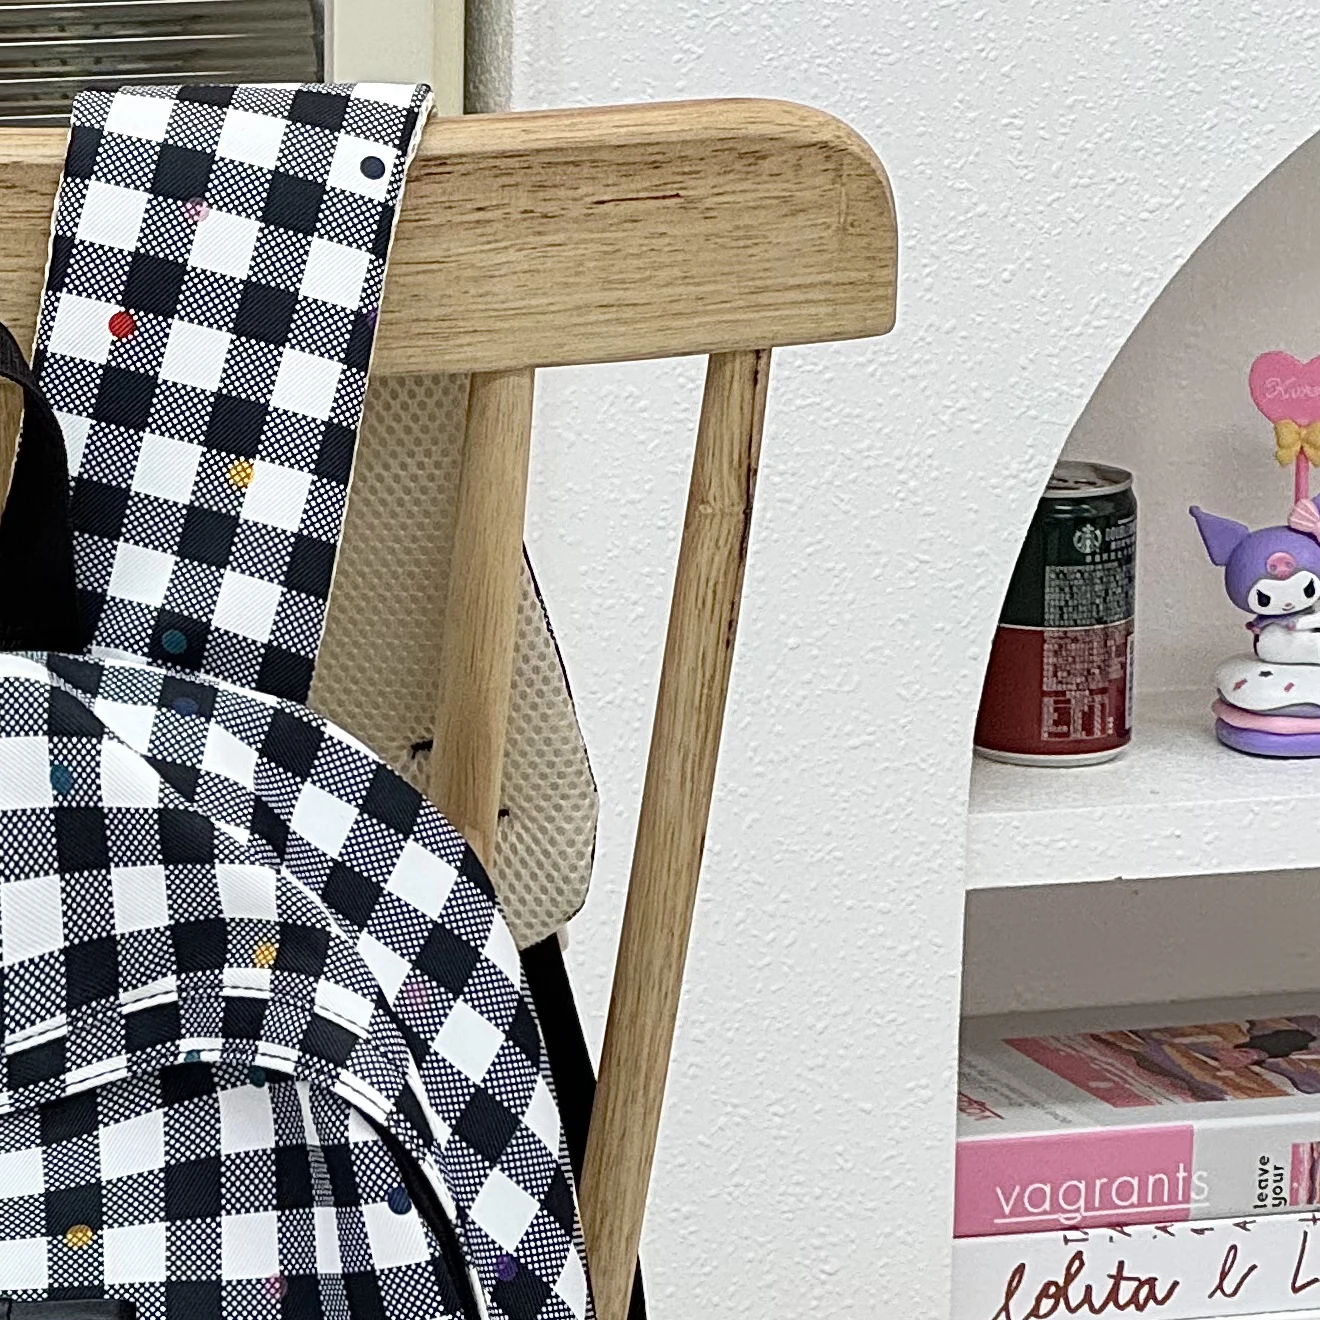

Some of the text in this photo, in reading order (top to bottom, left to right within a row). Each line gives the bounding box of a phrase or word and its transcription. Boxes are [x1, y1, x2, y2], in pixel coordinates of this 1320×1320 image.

[994, 1162, 1211, 1226] vagrants
[1252, 1155, 1270, 1210] leave
[1271, 1164, 1288, 1208] your
